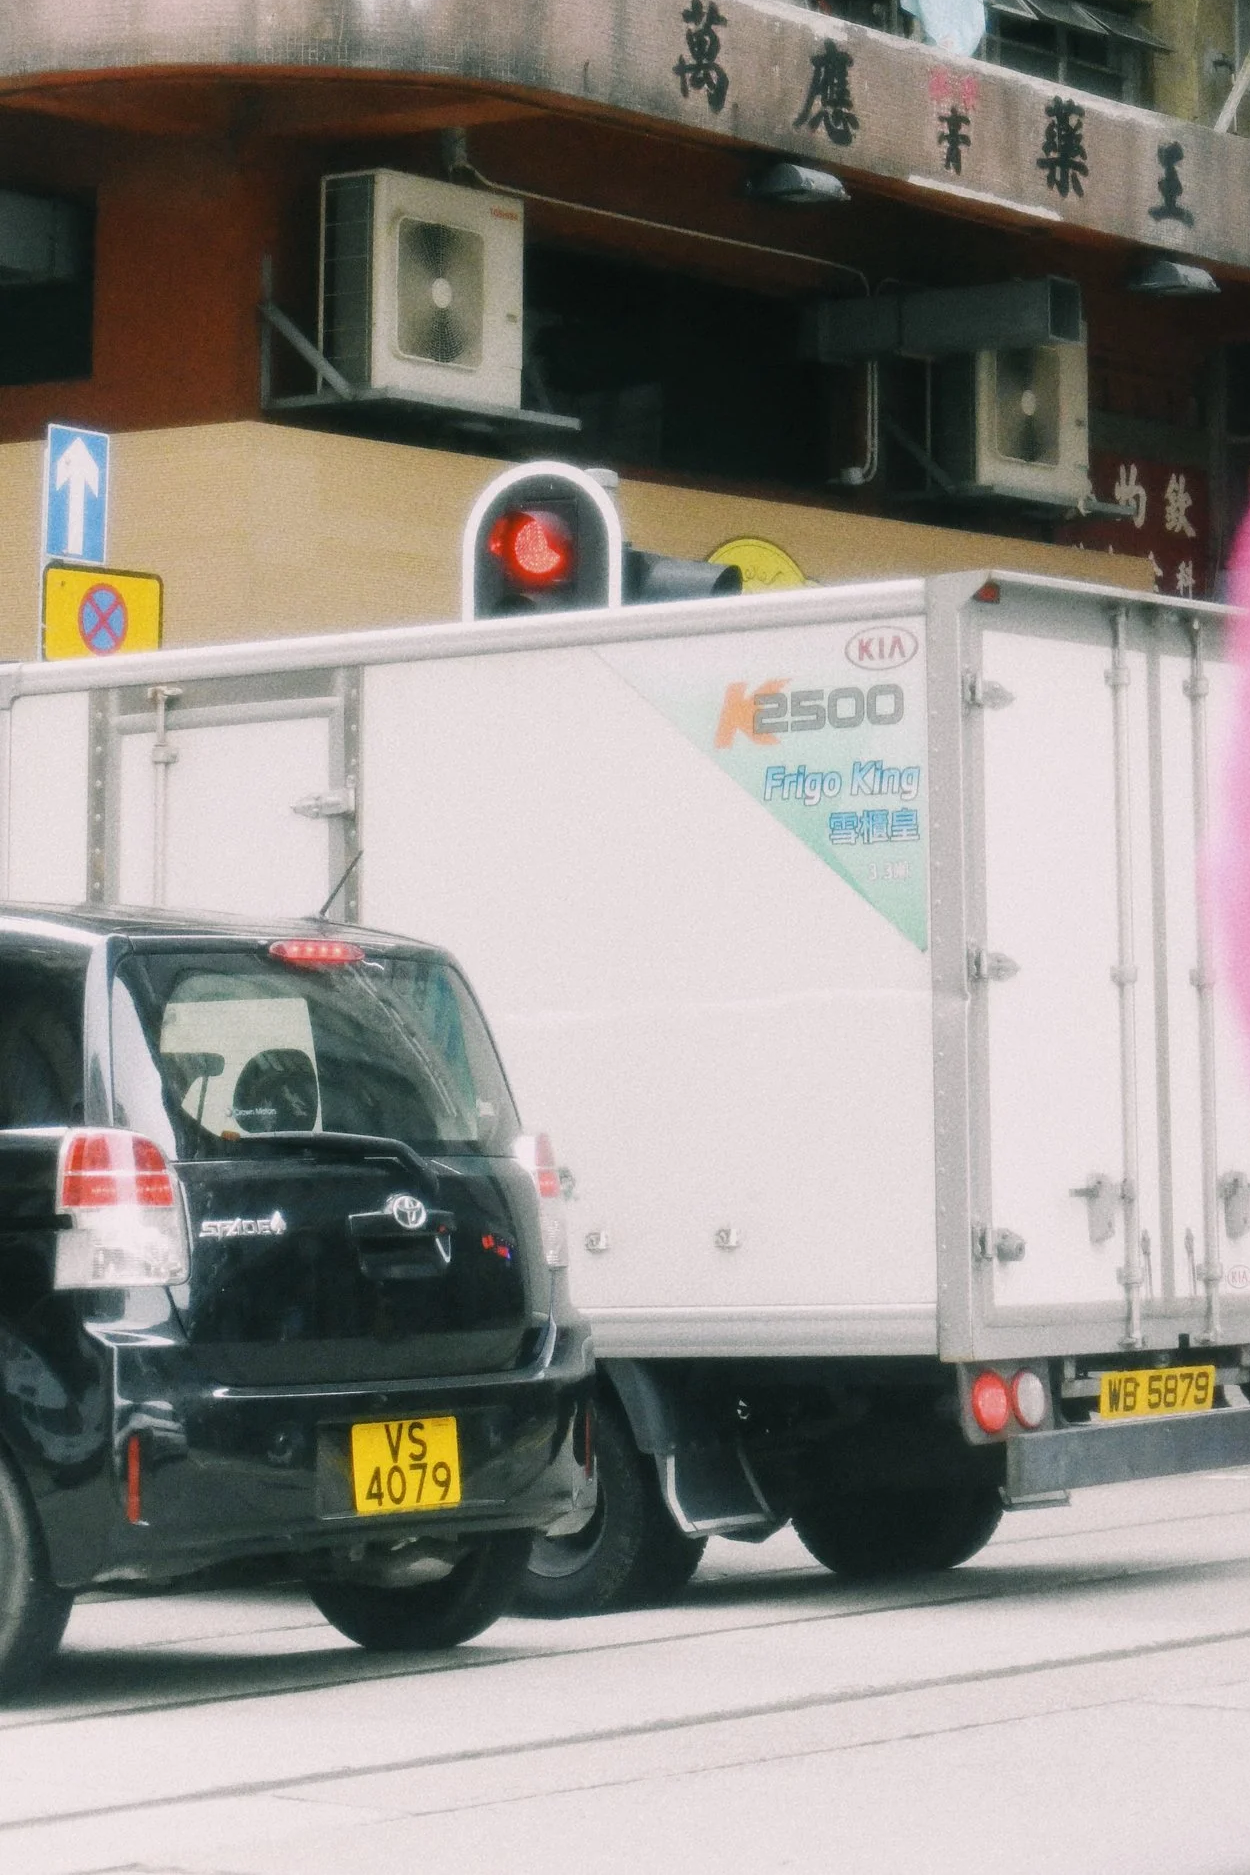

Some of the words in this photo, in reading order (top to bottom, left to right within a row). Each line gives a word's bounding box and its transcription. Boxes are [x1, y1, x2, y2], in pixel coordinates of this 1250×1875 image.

[857, 635, 906, 662] KIA
[713, 677, 905, 750] K2500
[763, 765, 843, 807] Frigo
[850, 760, 921, 801] King
[828, 807, 921, 845] 雪櫃皇
[1147, 1371, 1210, 1410] 5879
[384, 1421, 428, 1463] VS
[365, 1461, 452, 1507] 4079
